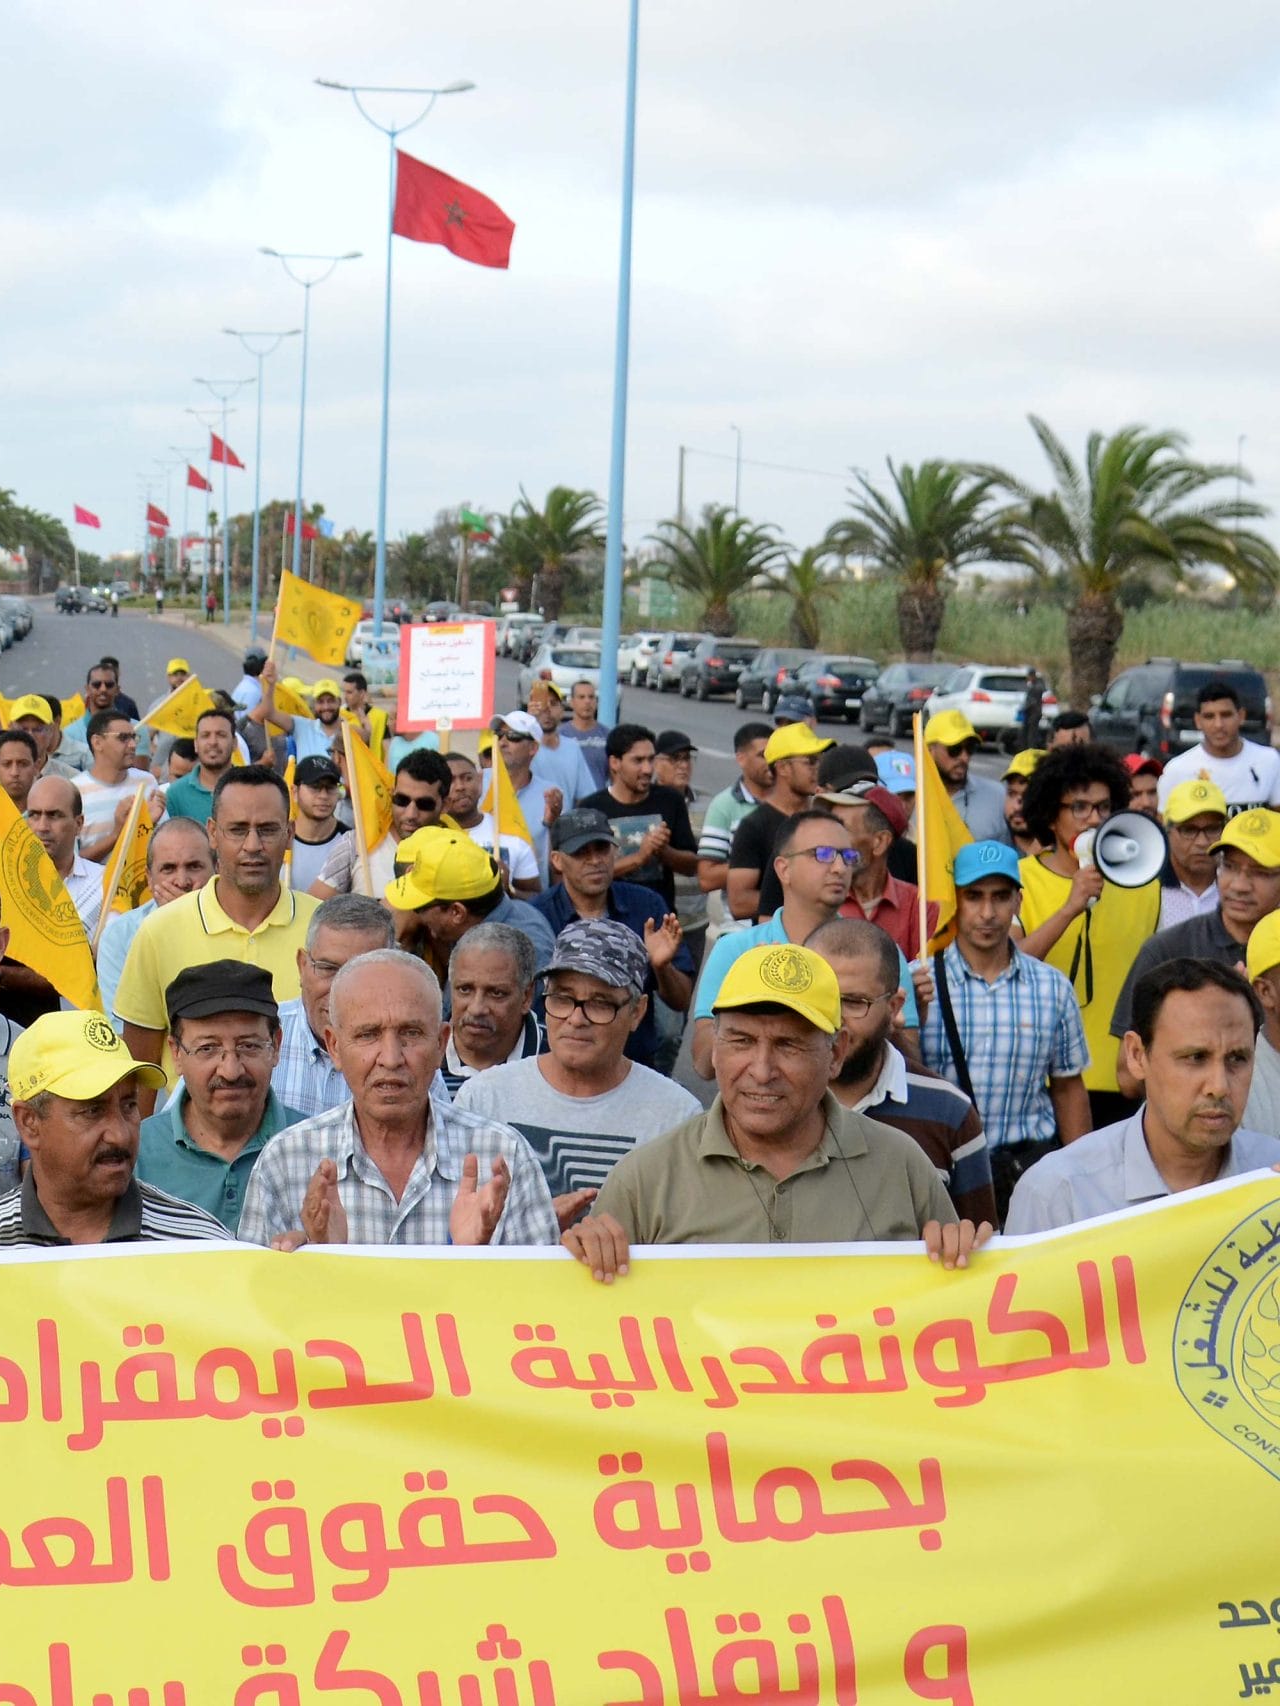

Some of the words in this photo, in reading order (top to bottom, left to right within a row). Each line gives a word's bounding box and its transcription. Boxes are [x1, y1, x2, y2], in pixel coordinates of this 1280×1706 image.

[511, 1255, 1147, 1409] الكونفدرالية
[593, 1431, 947, 1575] بحماية
[1234, 1424, 1280, 1462] CONF
[217, 1470, 558, 1608] حقوق
[597, 1595, 858, 1706] انقاد
[903, 1624, 975, 1706] و
